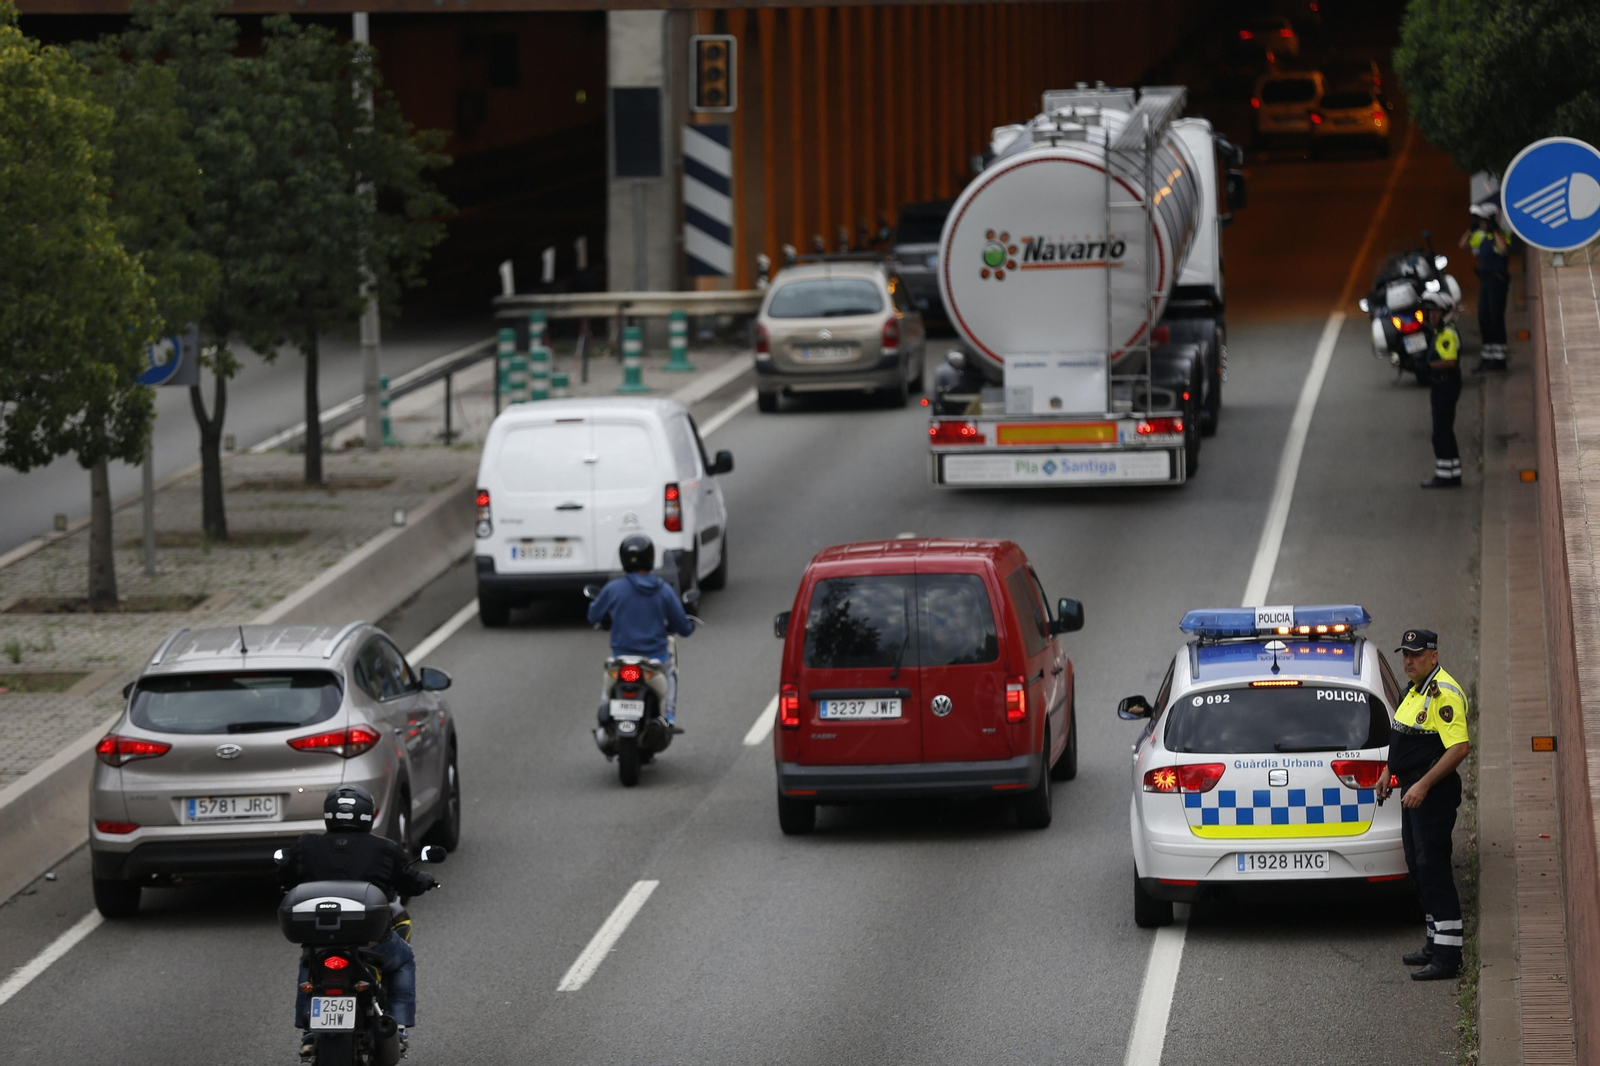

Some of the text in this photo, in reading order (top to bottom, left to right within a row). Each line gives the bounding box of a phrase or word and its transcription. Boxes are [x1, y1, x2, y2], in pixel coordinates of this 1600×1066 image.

[1023, 235, 1126, 262] Navarro
[1015, 460, 1039, 473] Pla
[1061, 459, 1116, 475] Santiga
[1258, 613, 1291, 623] POLICIA
[1206, 694, 1230, 704] 092
[1316, 690, 1366, 703] POLICIA
[830, 700, 898, 716] 3237 JWF
[1234, 758, 1324, 769] Guàrdia Urbana
[199, 798, 273, 814] 5781 JRC
[1249, 854, 1324, 869] 1928 HXG
[323, 1000, 354, 1013] 2549
[321, 1013, 344, 1026] JHW
